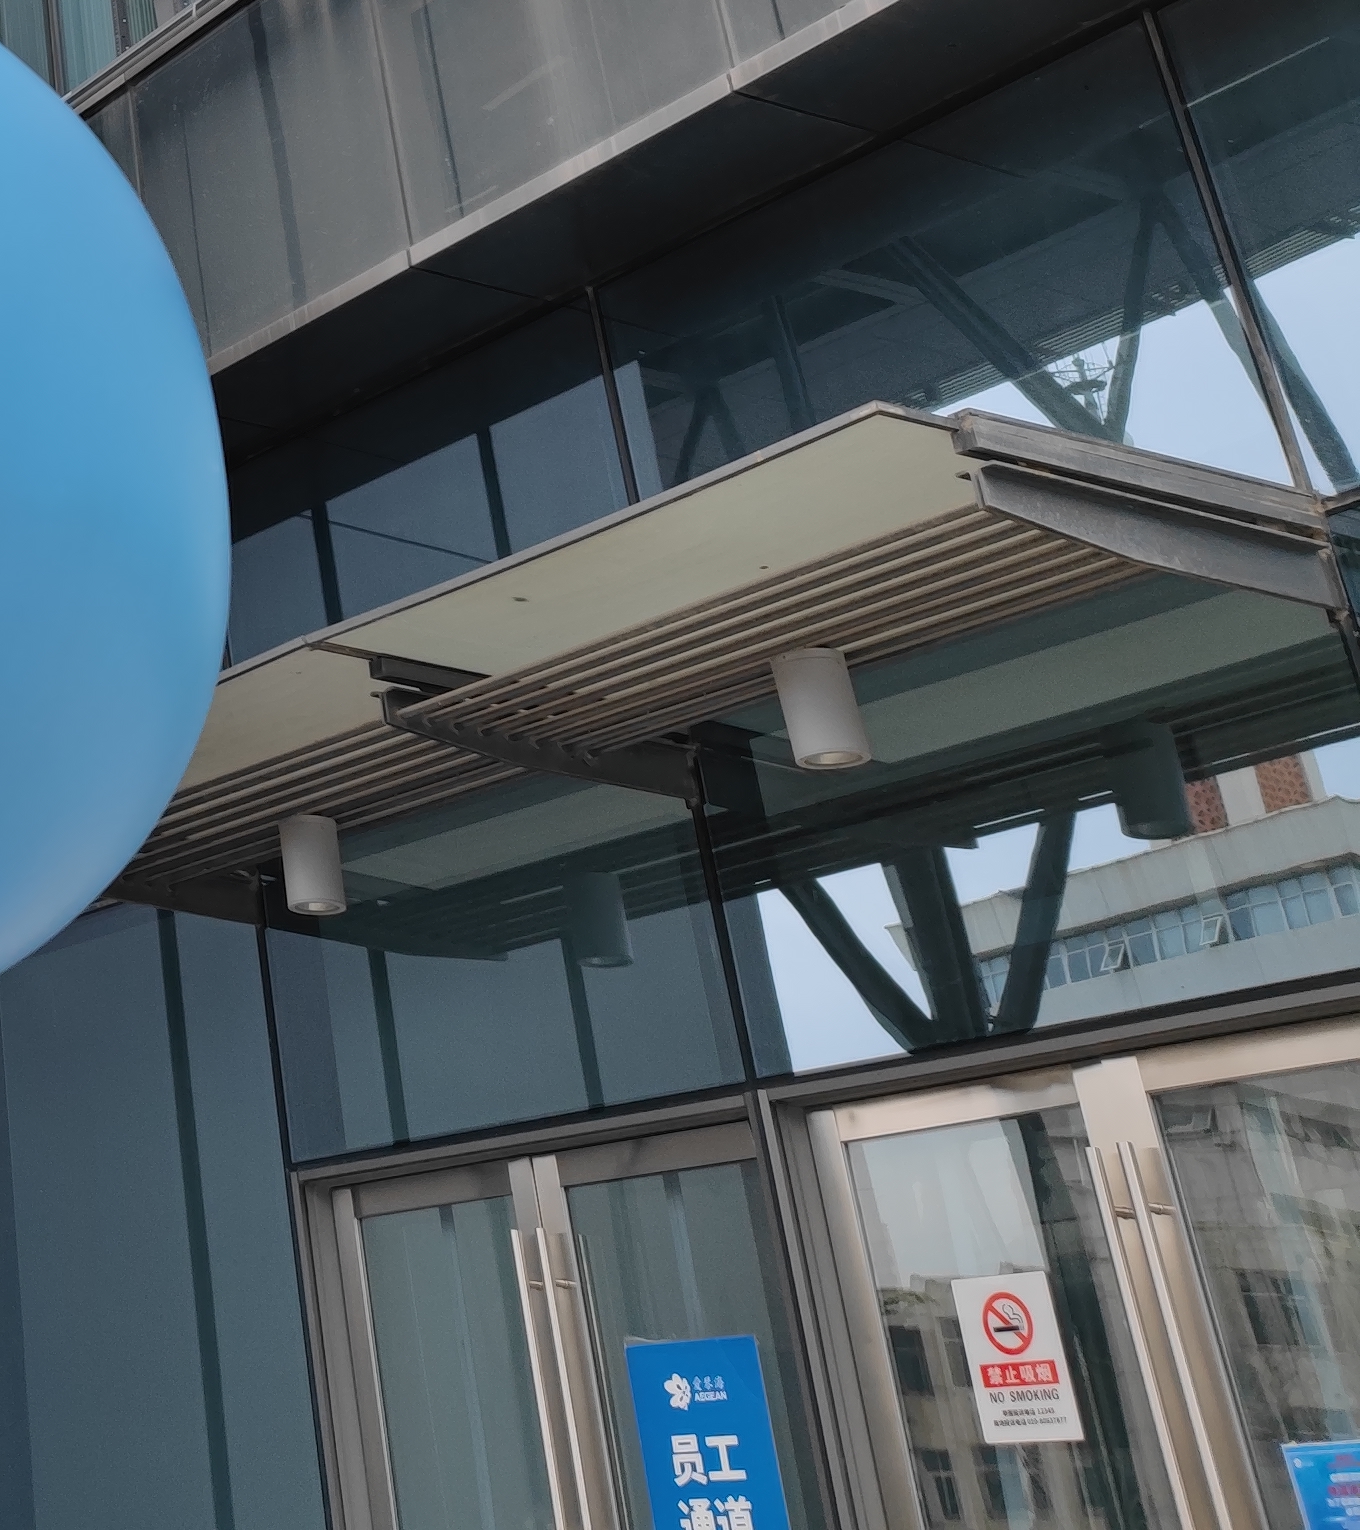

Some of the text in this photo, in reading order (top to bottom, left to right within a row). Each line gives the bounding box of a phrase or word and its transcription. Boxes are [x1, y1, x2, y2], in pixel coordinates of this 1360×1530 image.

[986, 1364, 1054, 1386] 禁止吸烟
[694, 1390, 728, 1402] AEGEAN
[989, 1388, 1060, 1404] NO SMOKING
[670, 1433, 748, 1487] 员工
[677, 1495, 755, 1530] 通道
